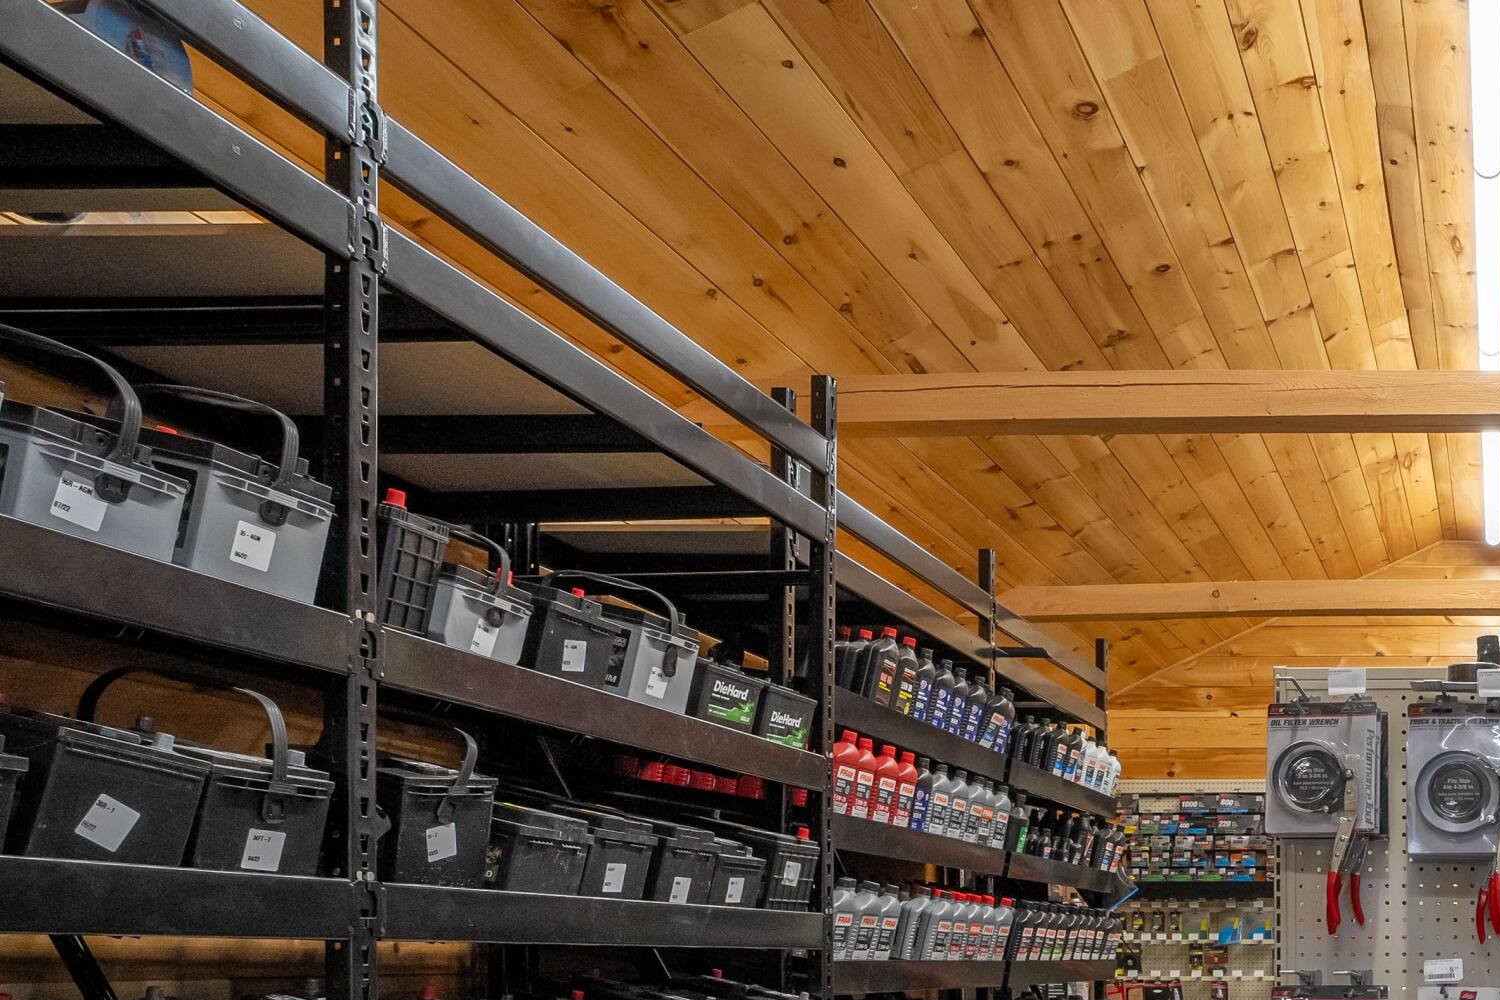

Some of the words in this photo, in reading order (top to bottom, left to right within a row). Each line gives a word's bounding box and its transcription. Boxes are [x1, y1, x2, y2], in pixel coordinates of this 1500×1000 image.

[713, 680, 749, 701] DieHard
[770, 710, 802, 728] DieHard
[1270, 719, 1282, 727] OIL
[1283, 718, 1307, 727] FILTER
[1309, 718, 1339, 726] WRENCH
